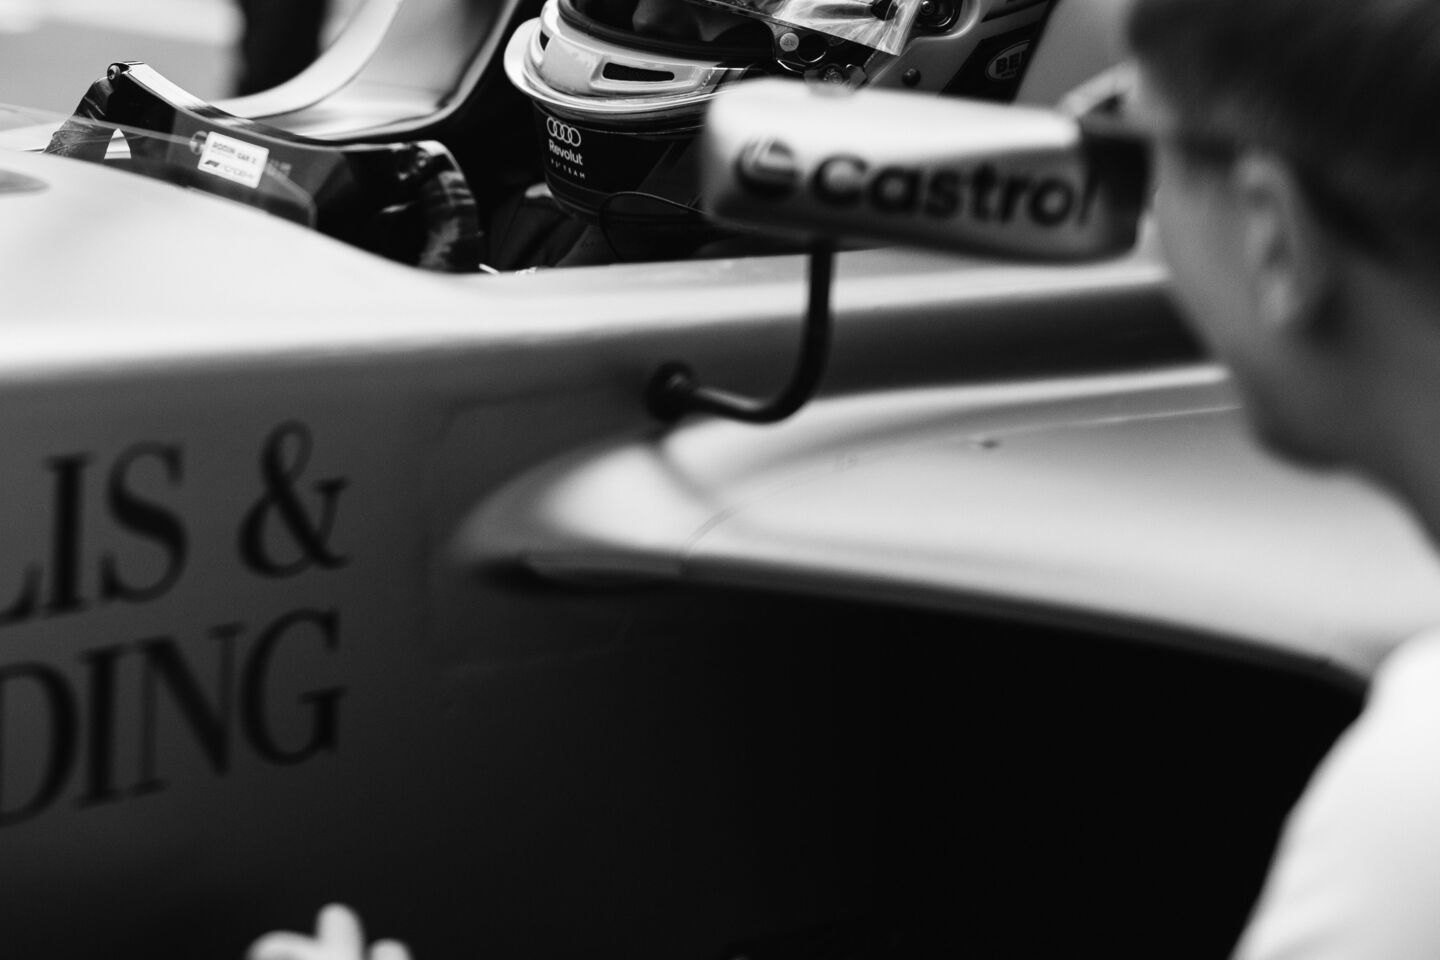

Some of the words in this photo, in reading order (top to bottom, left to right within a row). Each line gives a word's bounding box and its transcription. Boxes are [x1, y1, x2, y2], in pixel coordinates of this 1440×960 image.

[549, 139, 583, 166] Revolut
[809, 153, 1102, 228] Castrol
[235, 419, 353, 580] &
